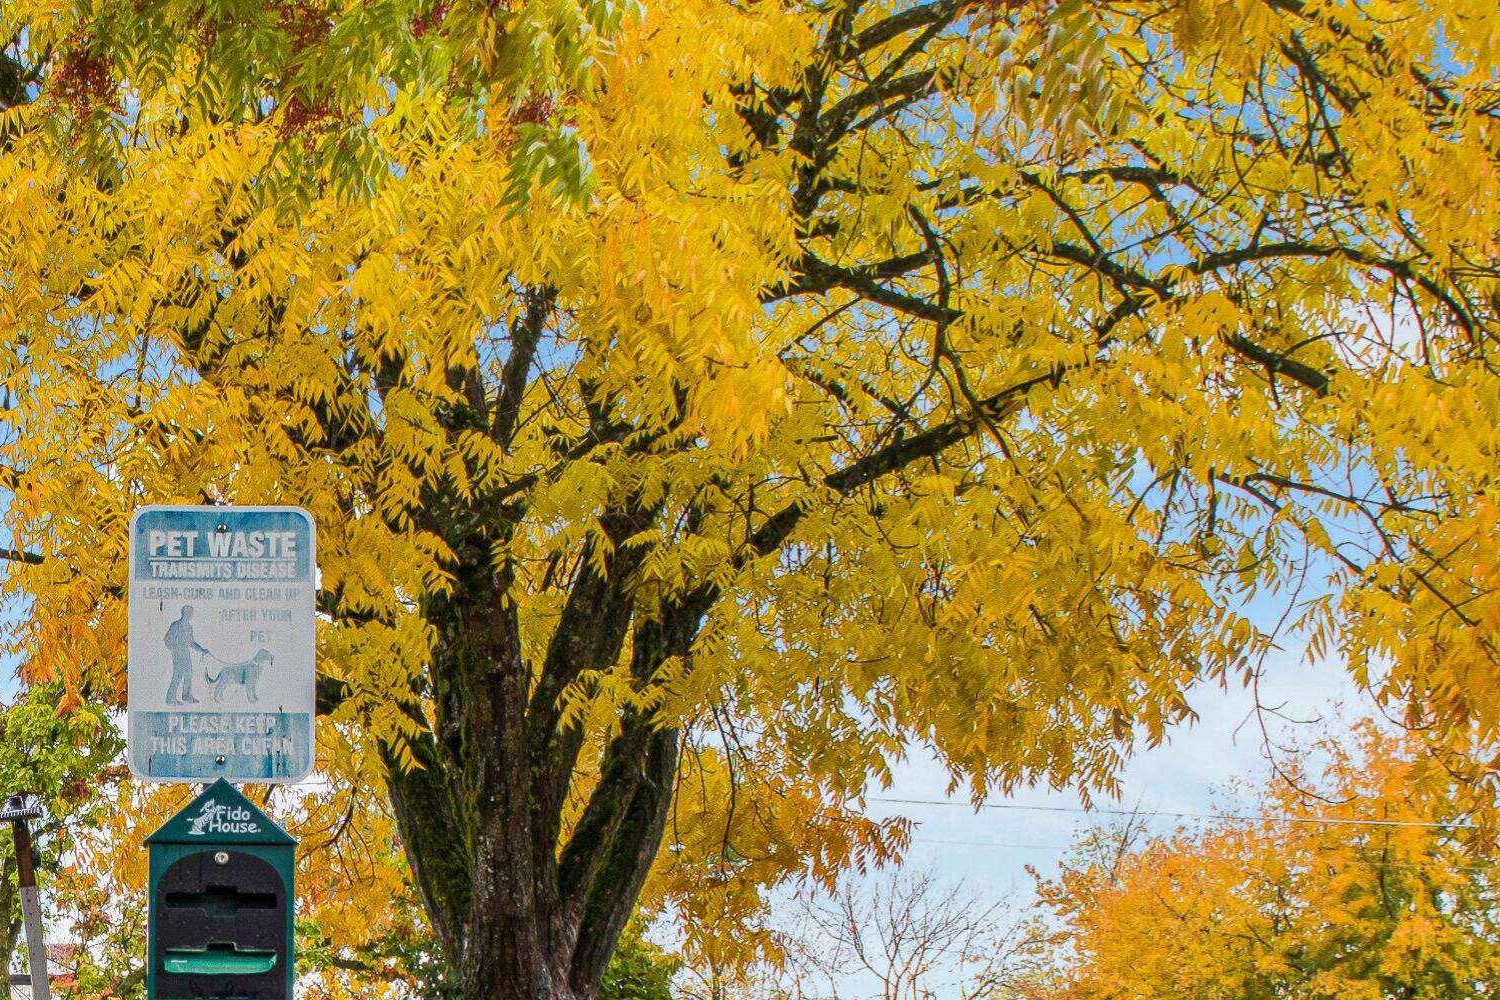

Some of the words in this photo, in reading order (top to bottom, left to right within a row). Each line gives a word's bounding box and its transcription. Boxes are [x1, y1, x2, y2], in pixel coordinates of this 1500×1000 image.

[150, 531, 198, 557] PET
[207, 531, 296, 557] WASTE
[151, 562, 232, 578] TRANSMITS
[235, 562, 297, 578] DISEASE
[218, 587, 240, 599] AND
[245, 588, 280, 600] CLEAN
[219, 608, 256, 621] AFTER
[260, 608, 292, 621] YOUR
[250, 630, 269, 643] PET
[168, 716, 229, 733] PLEASE
[233, 716, 277, 733] KEEP
[150, 736, 187, 754] THIS
[193, 736, 234, 754] AREA
[215, 805, 251, 821] Fido
